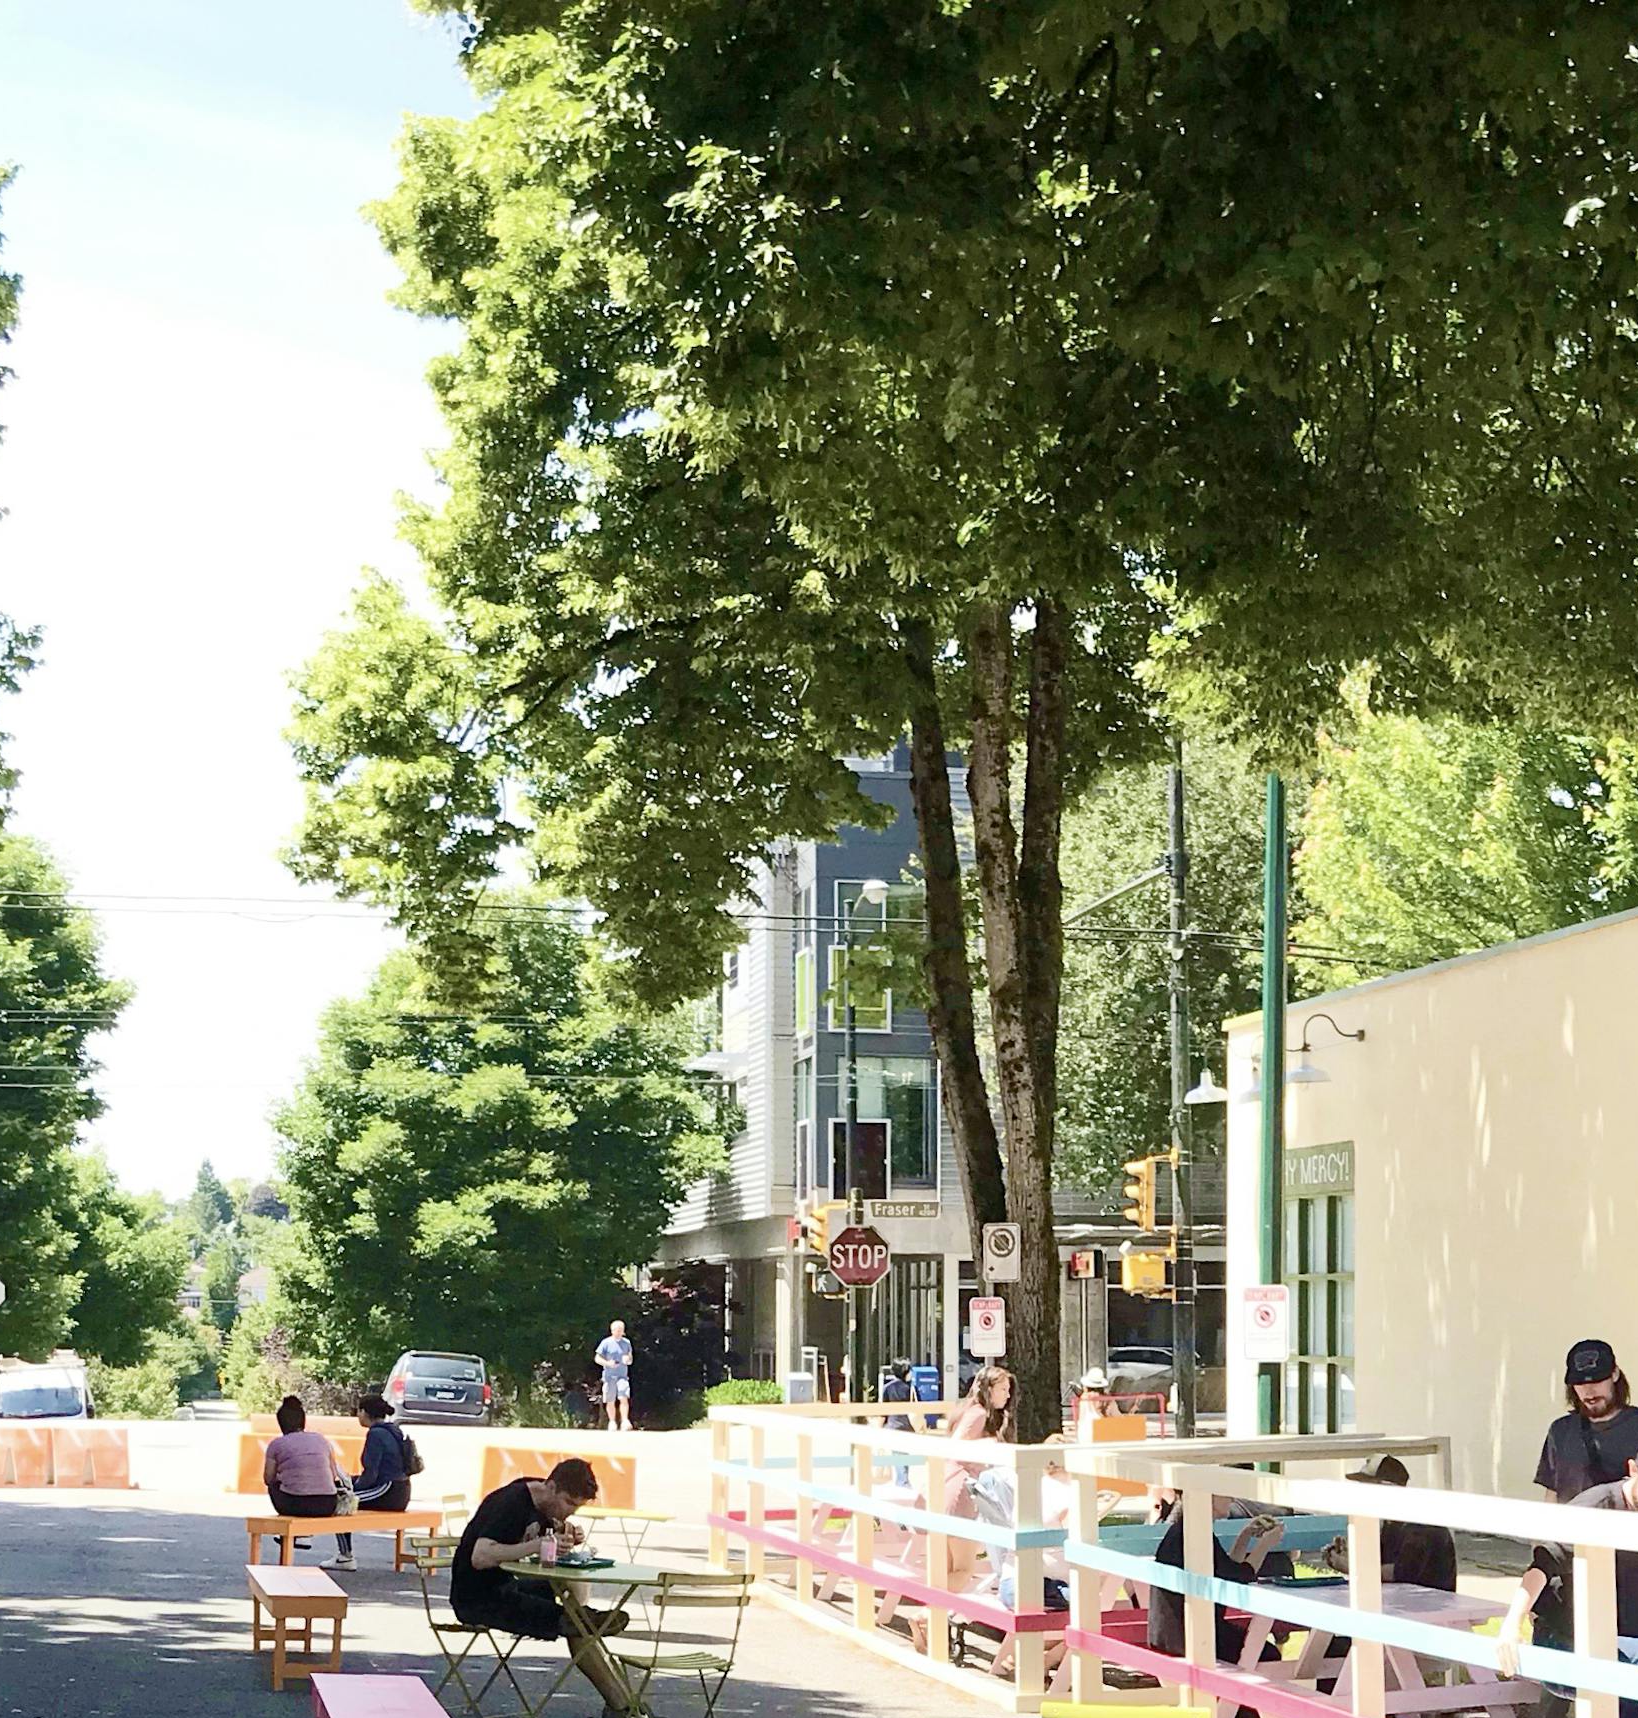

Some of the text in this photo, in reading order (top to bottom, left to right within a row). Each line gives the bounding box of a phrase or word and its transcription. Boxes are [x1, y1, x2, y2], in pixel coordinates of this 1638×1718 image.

[1300, 1151, 1349, 1185] MERCY!
[875, 1203, 916, 1216] Fraser
[832, 1244, 887, 1269] STOP
